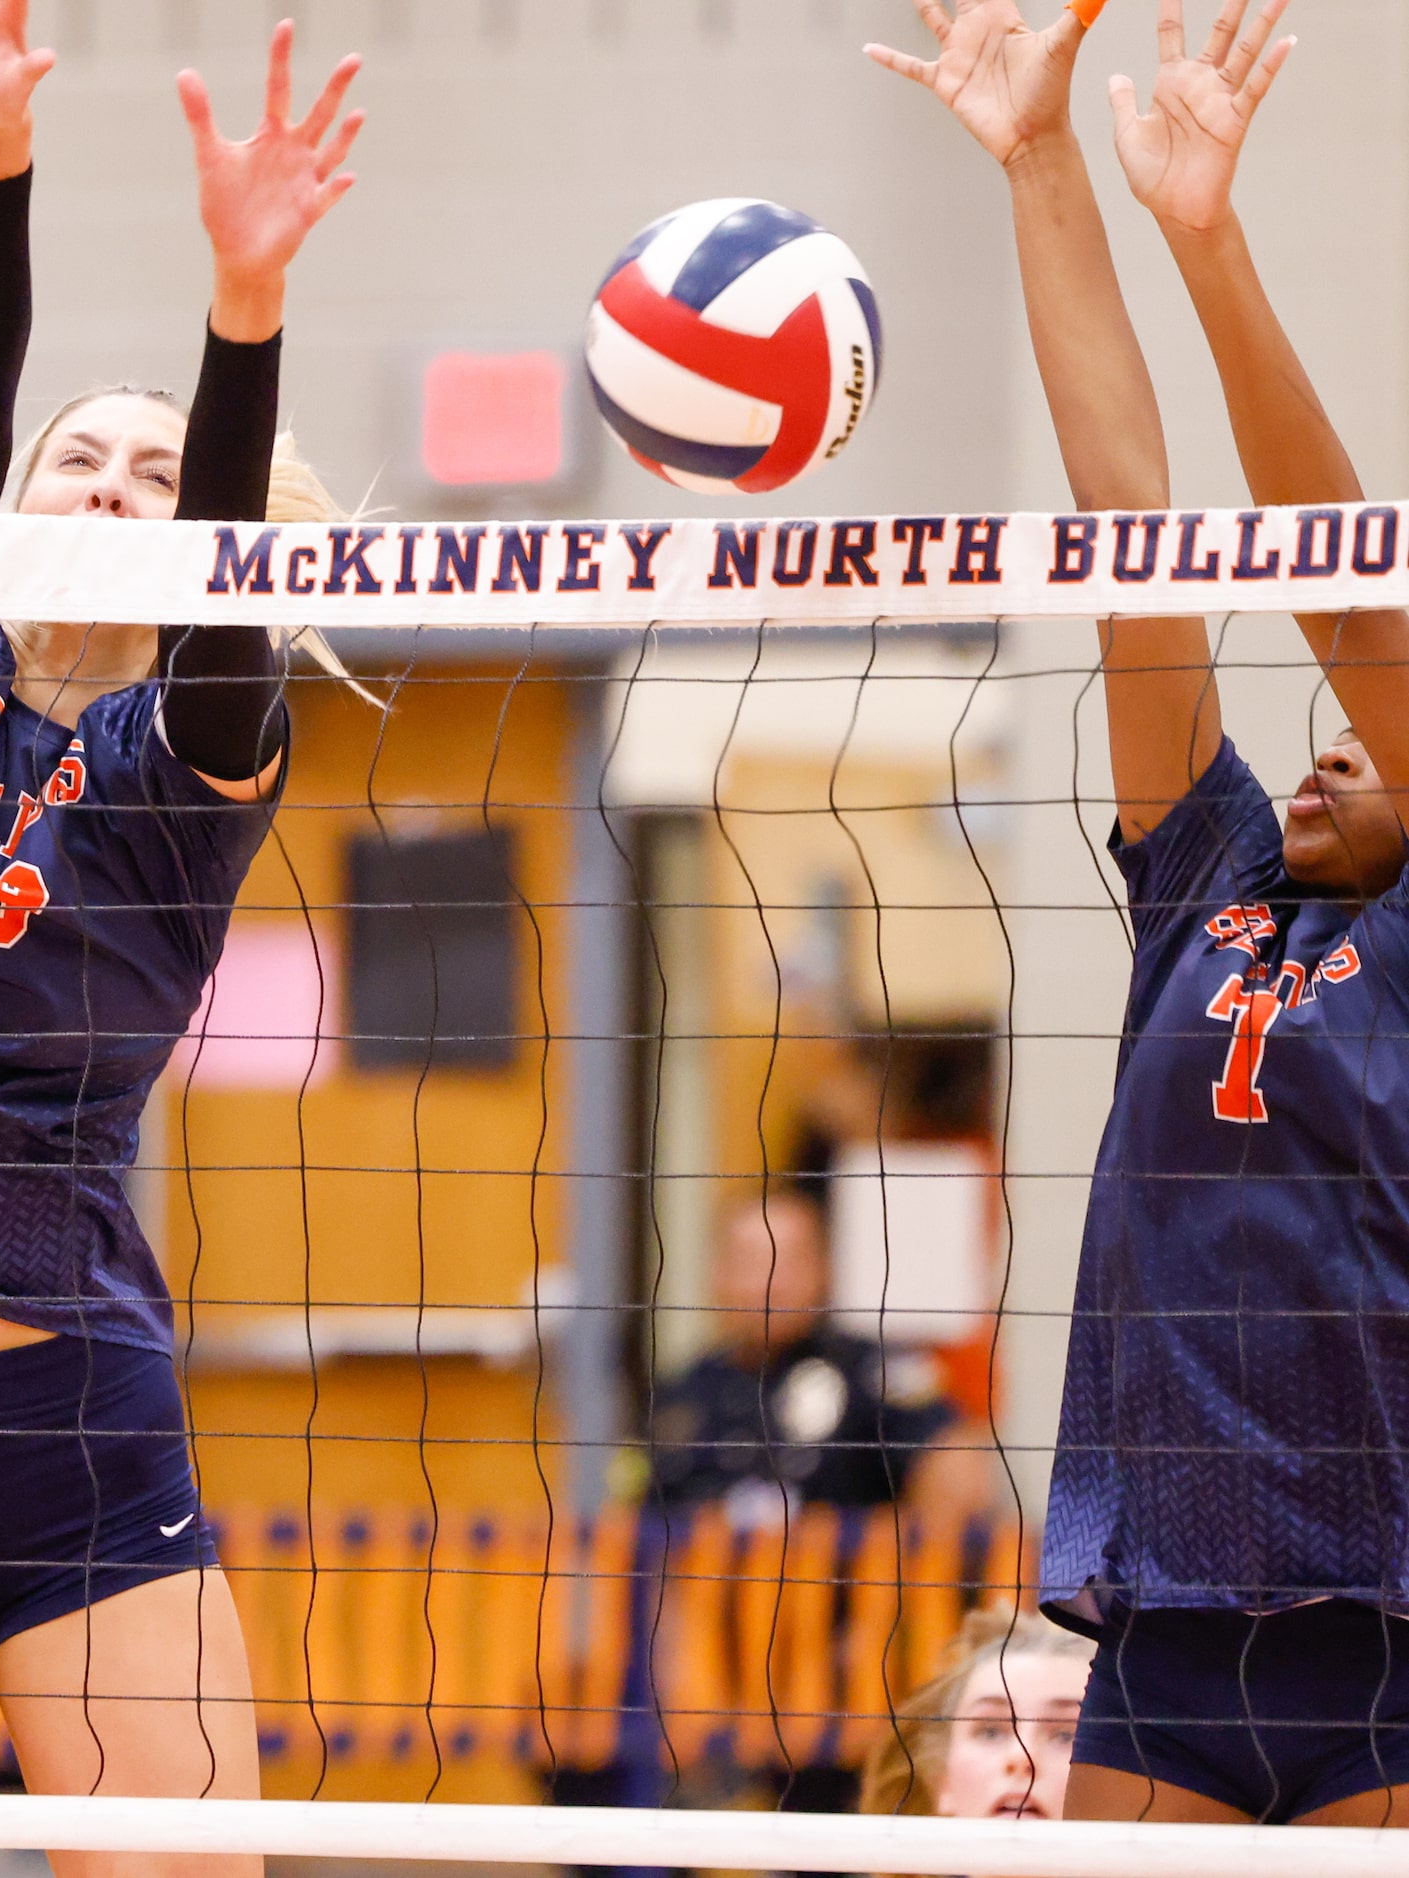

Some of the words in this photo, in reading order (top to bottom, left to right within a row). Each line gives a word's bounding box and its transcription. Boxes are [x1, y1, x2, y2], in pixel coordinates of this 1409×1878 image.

[206, 522, 673, 597] McKINNEY
[706, 514, 1010, 590] NORTH
[1047, 504, 1409, 584] BULLDO
